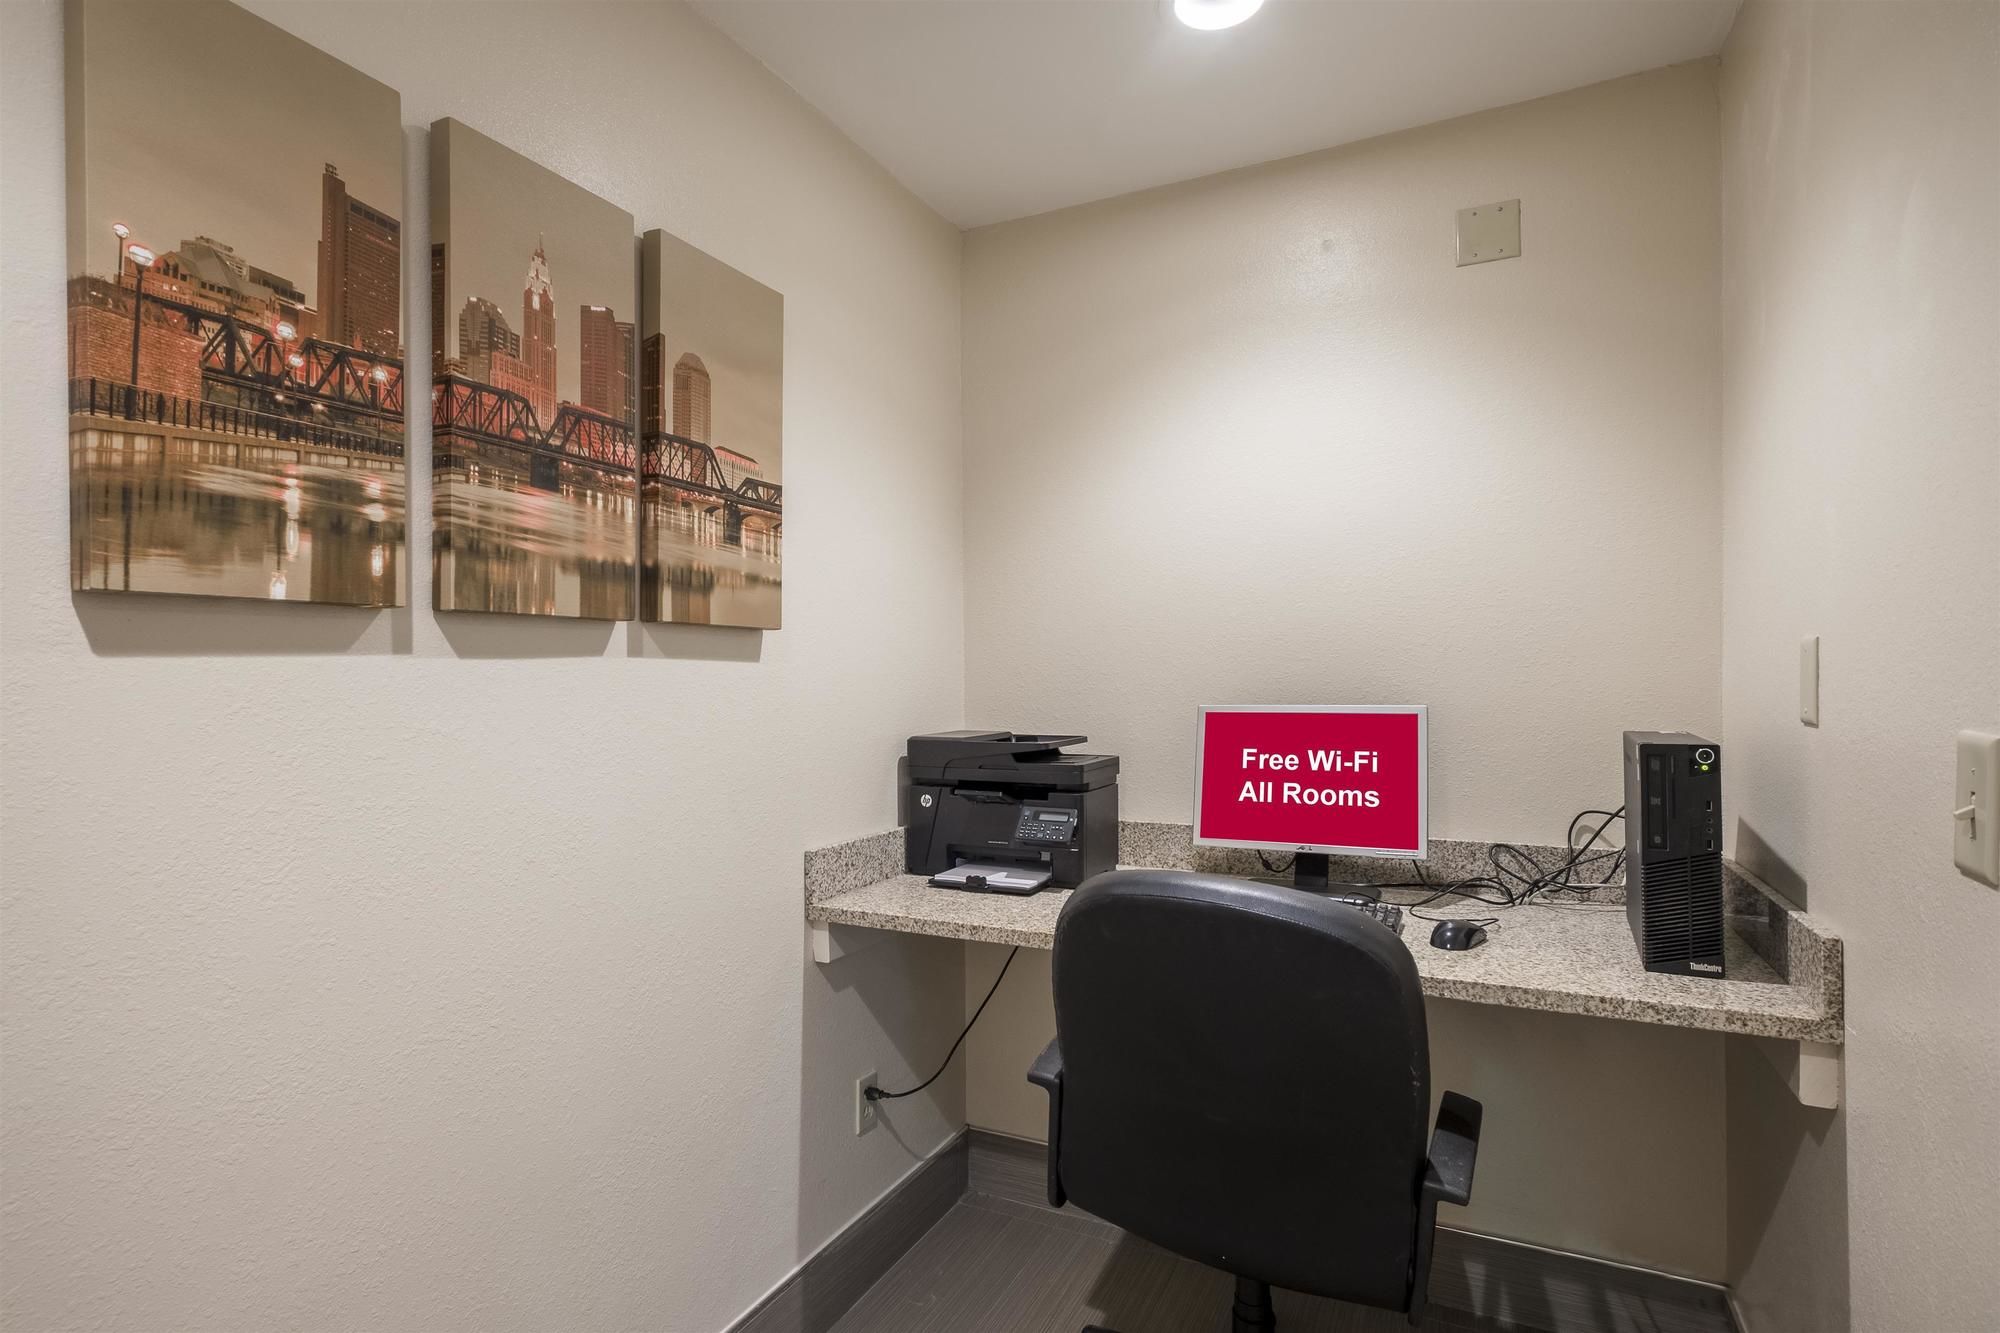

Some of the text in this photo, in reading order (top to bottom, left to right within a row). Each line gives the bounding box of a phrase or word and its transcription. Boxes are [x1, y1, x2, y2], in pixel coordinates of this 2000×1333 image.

[1242, 748, 1378, 773] Free Wi-Fi
[1238, 780, 1380, 808] All Rooms
